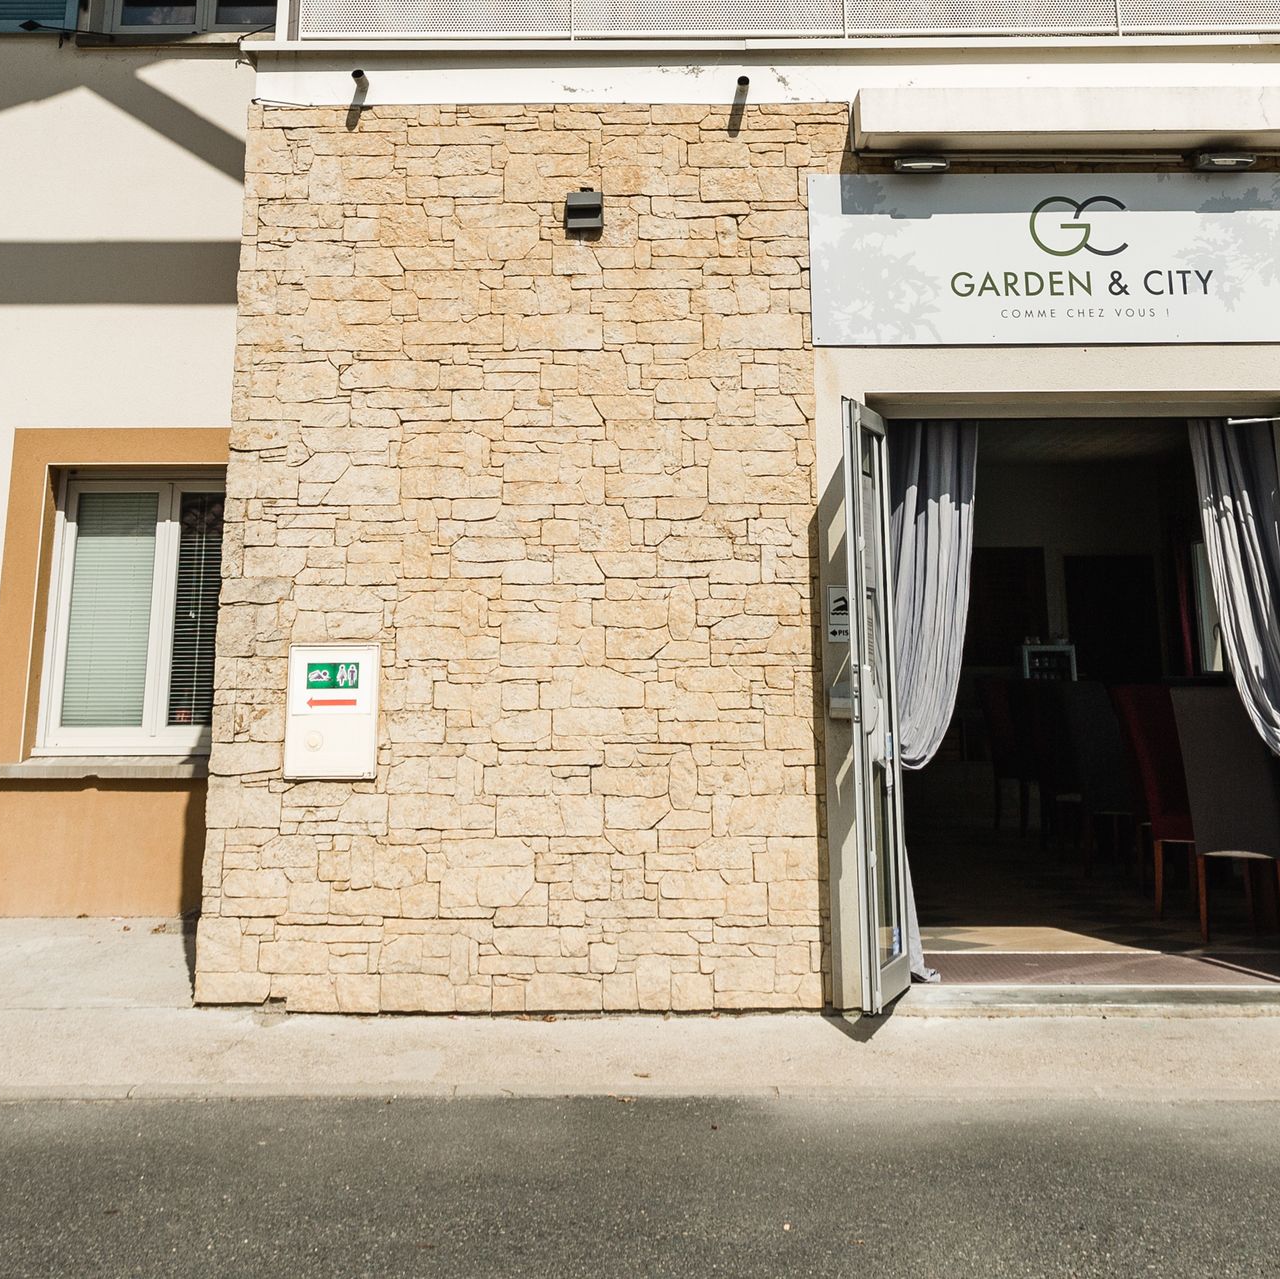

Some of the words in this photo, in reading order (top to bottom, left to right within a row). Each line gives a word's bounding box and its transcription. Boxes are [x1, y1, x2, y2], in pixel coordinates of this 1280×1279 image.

[1029, 195, 1129, 257] GC
[950, 270, 1093, 298] GARDEN
[1107, 269, 1130, 297] &
[1142, 269, 1215, 297] CITY
[1000, 308, 1058, 319] COMME
[1066, 307, 1106, 318] CHEZ
[1114, 307, 1157, 318] VOUS
